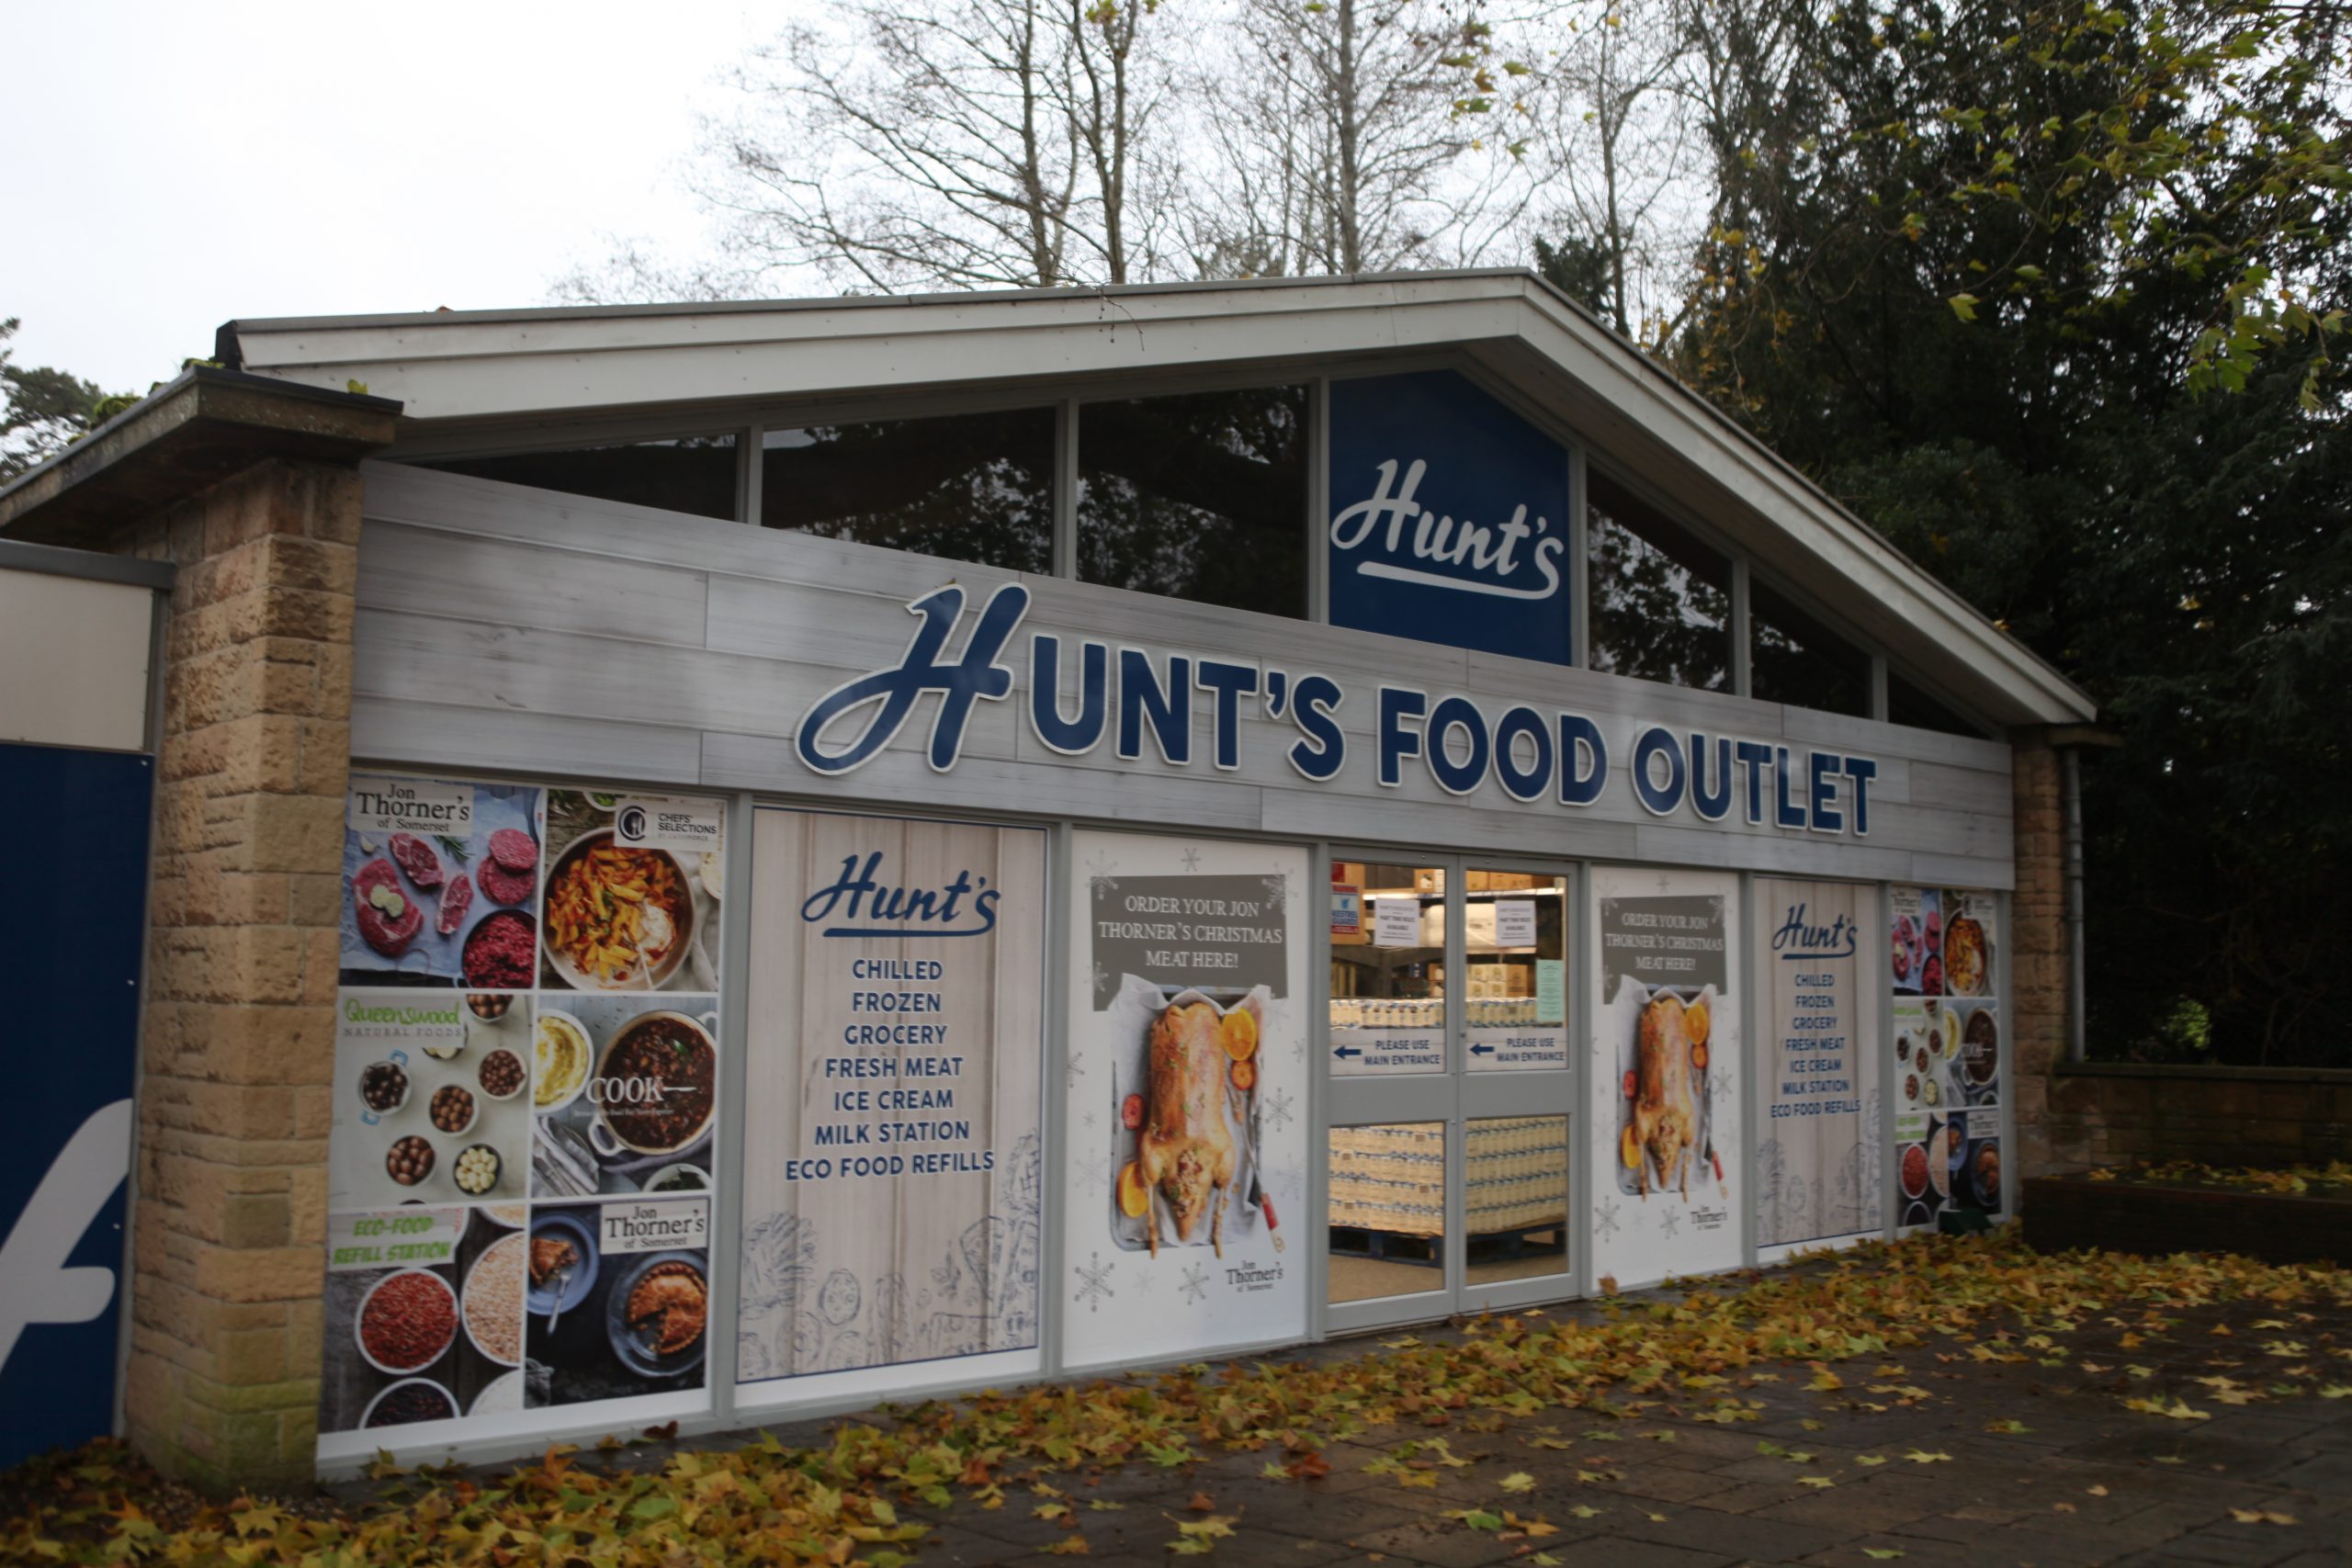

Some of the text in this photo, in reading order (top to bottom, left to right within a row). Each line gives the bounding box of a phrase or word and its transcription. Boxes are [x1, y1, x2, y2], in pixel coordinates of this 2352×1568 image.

[1330, 458, 1564, 600] Hunt's
[795, 581, 1877, 836] HUNT'S FOOD OUTLET
[388, 784, 415, 799] Jon
[356, 792, 469, 820] Thorner's
[378, 818, 449, 832] of Somerset
[658, 822, 717, 834] SELECTIONS
[800, 852, 1001, 938] Hunt's
[1125, 896, 1260, 918] ORDER YOUR JON
[1622, 913, 1657, 927] ORDER
[1658, 915, 1687, 929] YOUR
[1098, 921, 1283, 943] THORNER'S CHRISTMAS
[1771, 903, 1858, 960] Hunt's
[1667, 936, 1724, 951] CHRISTMAS
[1146, 950, 1238, 968] MEAT HERE!
[853, 959, 944, 980] CHILLED
[1795, 974, 1835, 987] CHILLED
[345, 998, 460, 1025] Queenswood
[852, 992, 942, 1012] FROZEN
[1795, 995, 1835, 1009] FROZEN
[343, 1028, 462, 1037] NATURAL FOODS
[1793, 1016, 1838, 1030] GROCERY
[844, 1024, 948, 1045] GROCERY
[1506, 1037, 1555, 1047] PLEASE USE
[1786, 1036, 1845, 1052] FRESH MEAT
[1375, 1039, 1430, 1050] PLEASE USE
[1364, 1055, 1441, 1066] MAIN ENTRANCE
[1498, 1052, 1565, 1062] MAIN ENTRANCE
[1790, 1058, 1841, 1073] ICE CREAM
[825, 1056, 963, 1078] FRESH MEAT
[585, 1076, 664, 1103] COOK
[1782, 1079, 1849, 1095] MILK STATION
[833, 1089, 954, 1111] ICE CREAM
[1771, 1100, 1860, 1118] ECO FOOD REFILLS
[814, 1121, 969, 1146] MILK STATION
[786, 1151, 994, 1180] ECO FOOD REFILLS
[632, 1205, 657, 1220] Jon
[353, 1216, 434, 1236] ECO-FOOD
[605, 1209, 705, 1237] Thorner's
[333, 1241, 451, 1265] REFILL STATION
